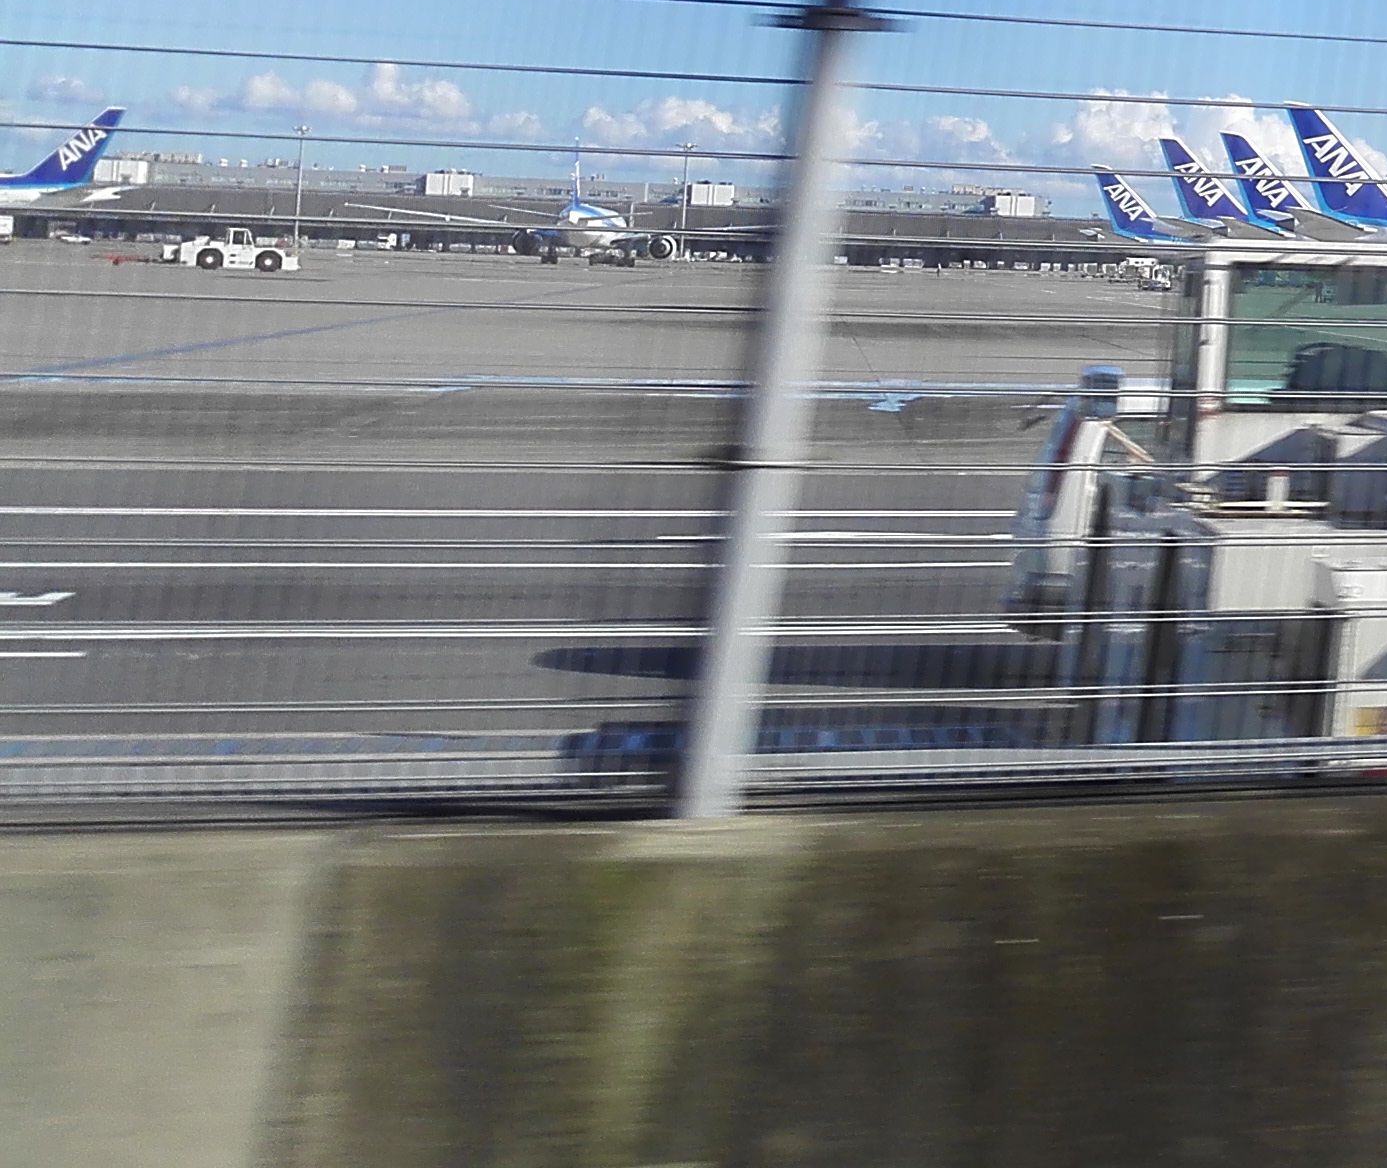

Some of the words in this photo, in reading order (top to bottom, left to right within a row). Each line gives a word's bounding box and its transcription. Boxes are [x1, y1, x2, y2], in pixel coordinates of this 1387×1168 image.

[58, 123, 107, 171] ANA
[1303, 133, 1369, 197] ANA
[1103, 183, 1144, 221] ANA
[1173, 162, 1224, 207] ANA
[1235, 157, 1289, 208] ANA
